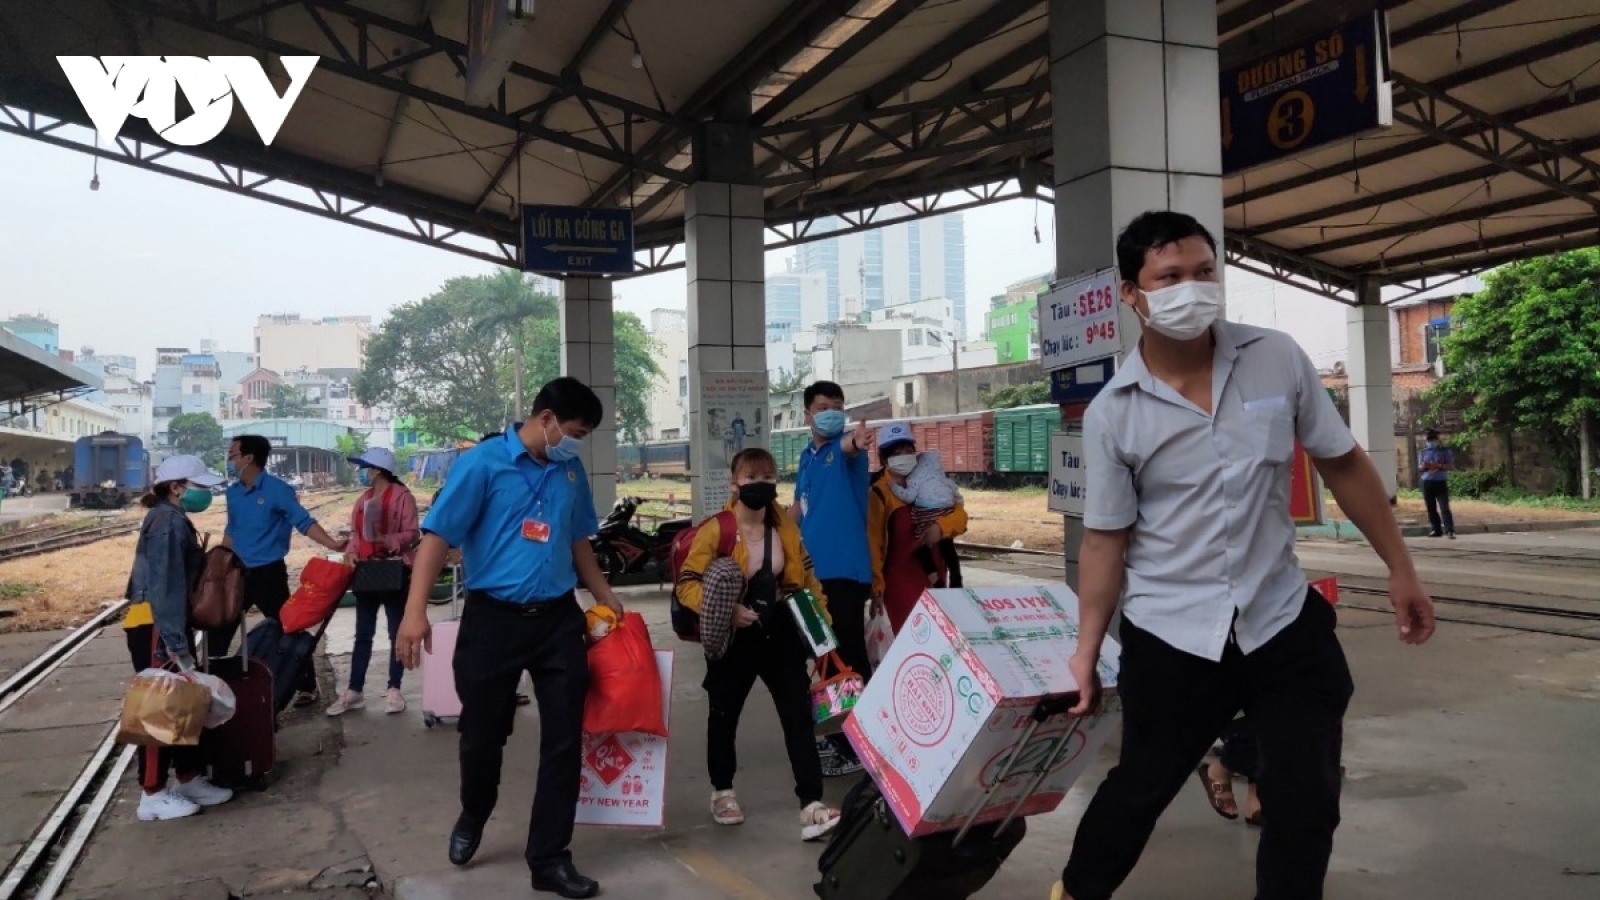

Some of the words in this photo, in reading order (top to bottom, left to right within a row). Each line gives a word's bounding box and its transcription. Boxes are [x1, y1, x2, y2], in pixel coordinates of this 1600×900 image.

[1278, 98, 1305, 142] 3
[554, 217, 571, 239] RA
[610, 219, 625, 241] GA
[567, 255, 593, 266] EXIT
[1050, 302, 1070, 321] Tàu
[1079, 284, 1113, 317] SE26
[1061, 450, 1080, 469] Tàu
[597, 797, 620, 807] NEW
[622, 799, 649, 808] YEAR
